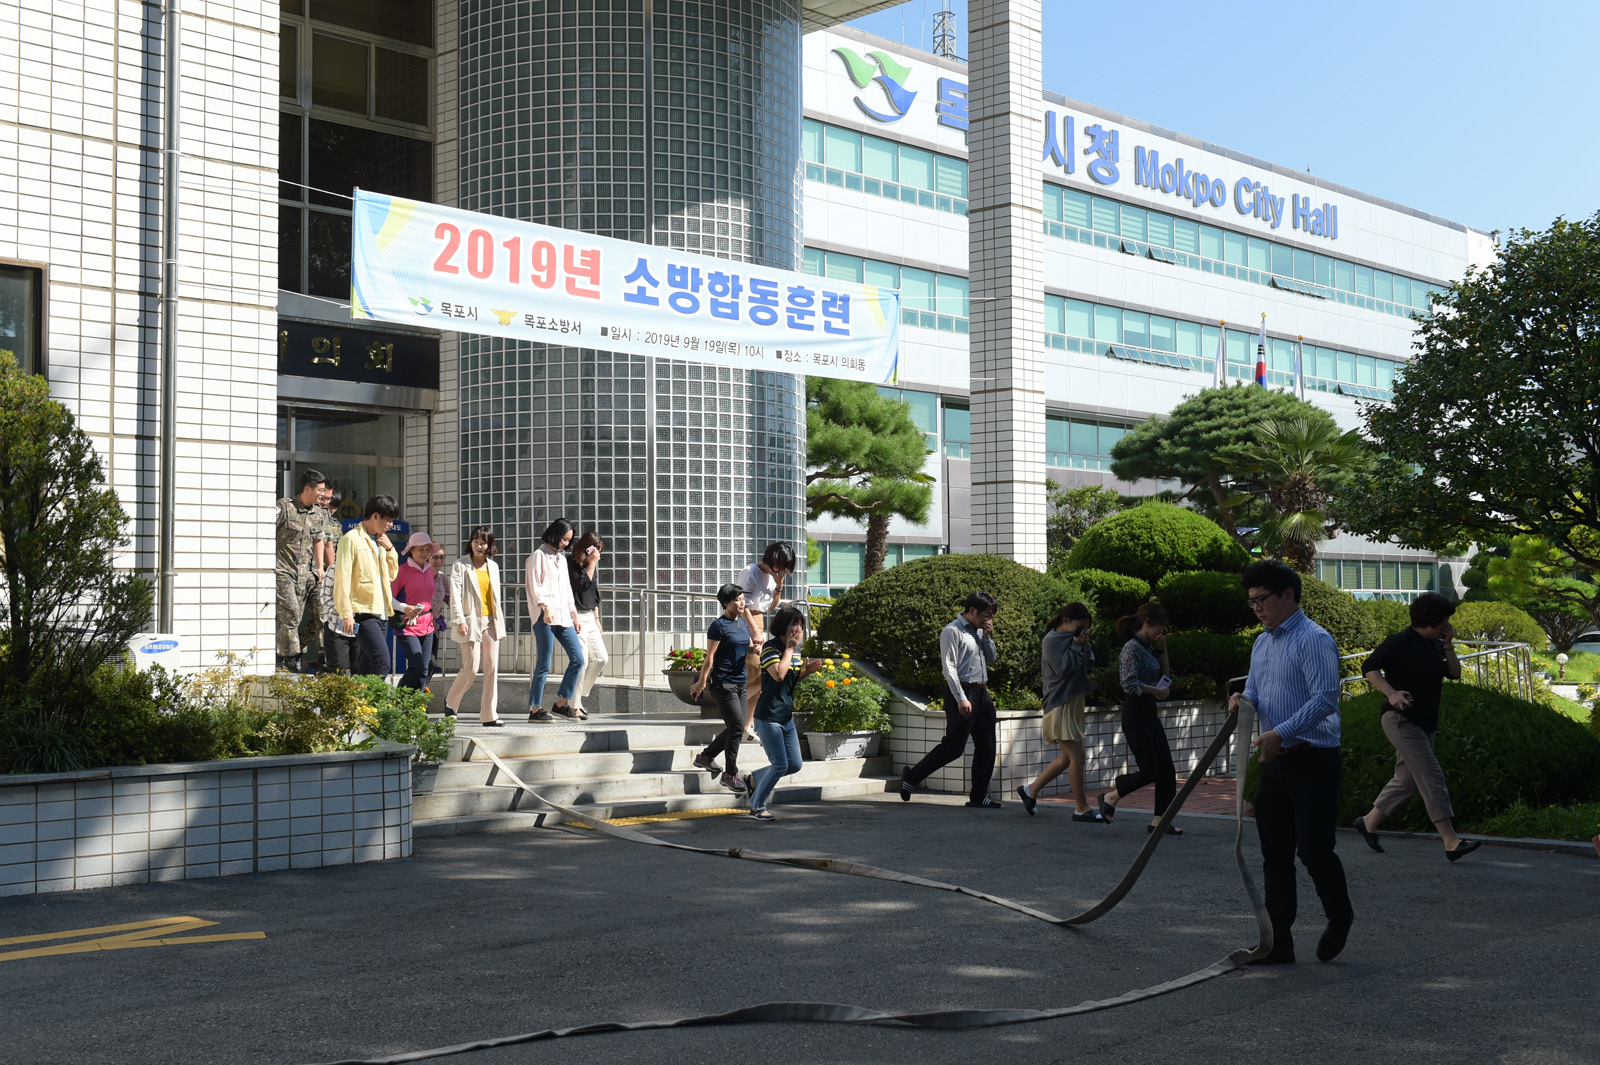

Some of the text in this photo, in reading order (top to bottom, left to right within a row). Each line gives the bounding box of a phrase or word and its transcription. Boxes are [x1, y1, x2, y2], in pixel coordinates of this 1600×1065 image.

[1134, 145, 1338, 239] Mokpo City Hall
[433, 222, 851, 337] 2019년 소방합동훈련
[441, 302, 478, 321] 목포시
[524, 314, 582, 335] 목포소방서
[644, 331, 680, 348] 2019년
[683, 336, 700, 350] 9월
[704, 340, 741, 356] 19일(목)
[745, 345, 764, 359] 10시
[813, 353, 838, 368] 목포시
[841, 357, 866, 371] 의회동
